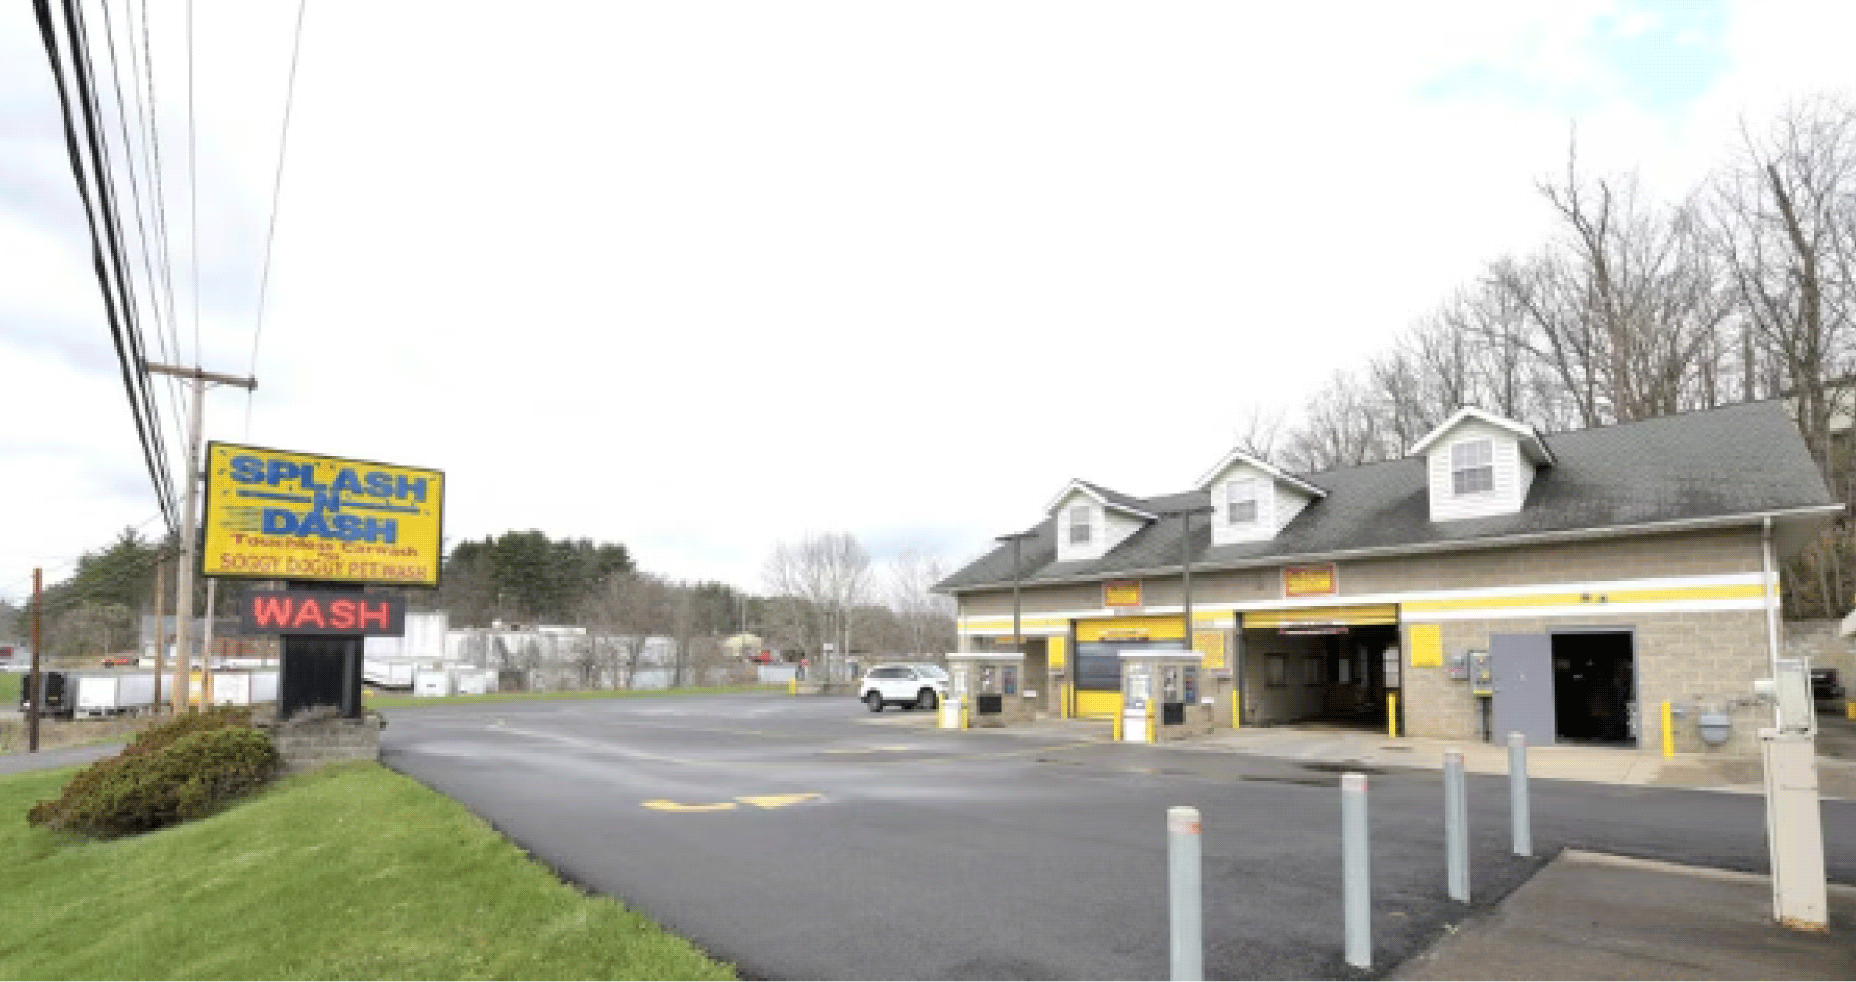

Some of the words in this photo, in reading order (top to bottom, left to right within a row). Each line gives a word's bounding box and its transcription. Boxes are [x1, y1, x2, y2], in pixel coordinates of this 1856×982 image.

[230, 455, 427, 501] SPLASH
[313, 484, 341, 513] N
[263, 508, 398, 544] DASH
[231, 533, 334, 552] Touchless
[220, 552, 281, 573] SOGGY
[347, 560, 378, 579] PET
[253, 597, 390, 630] WASH
